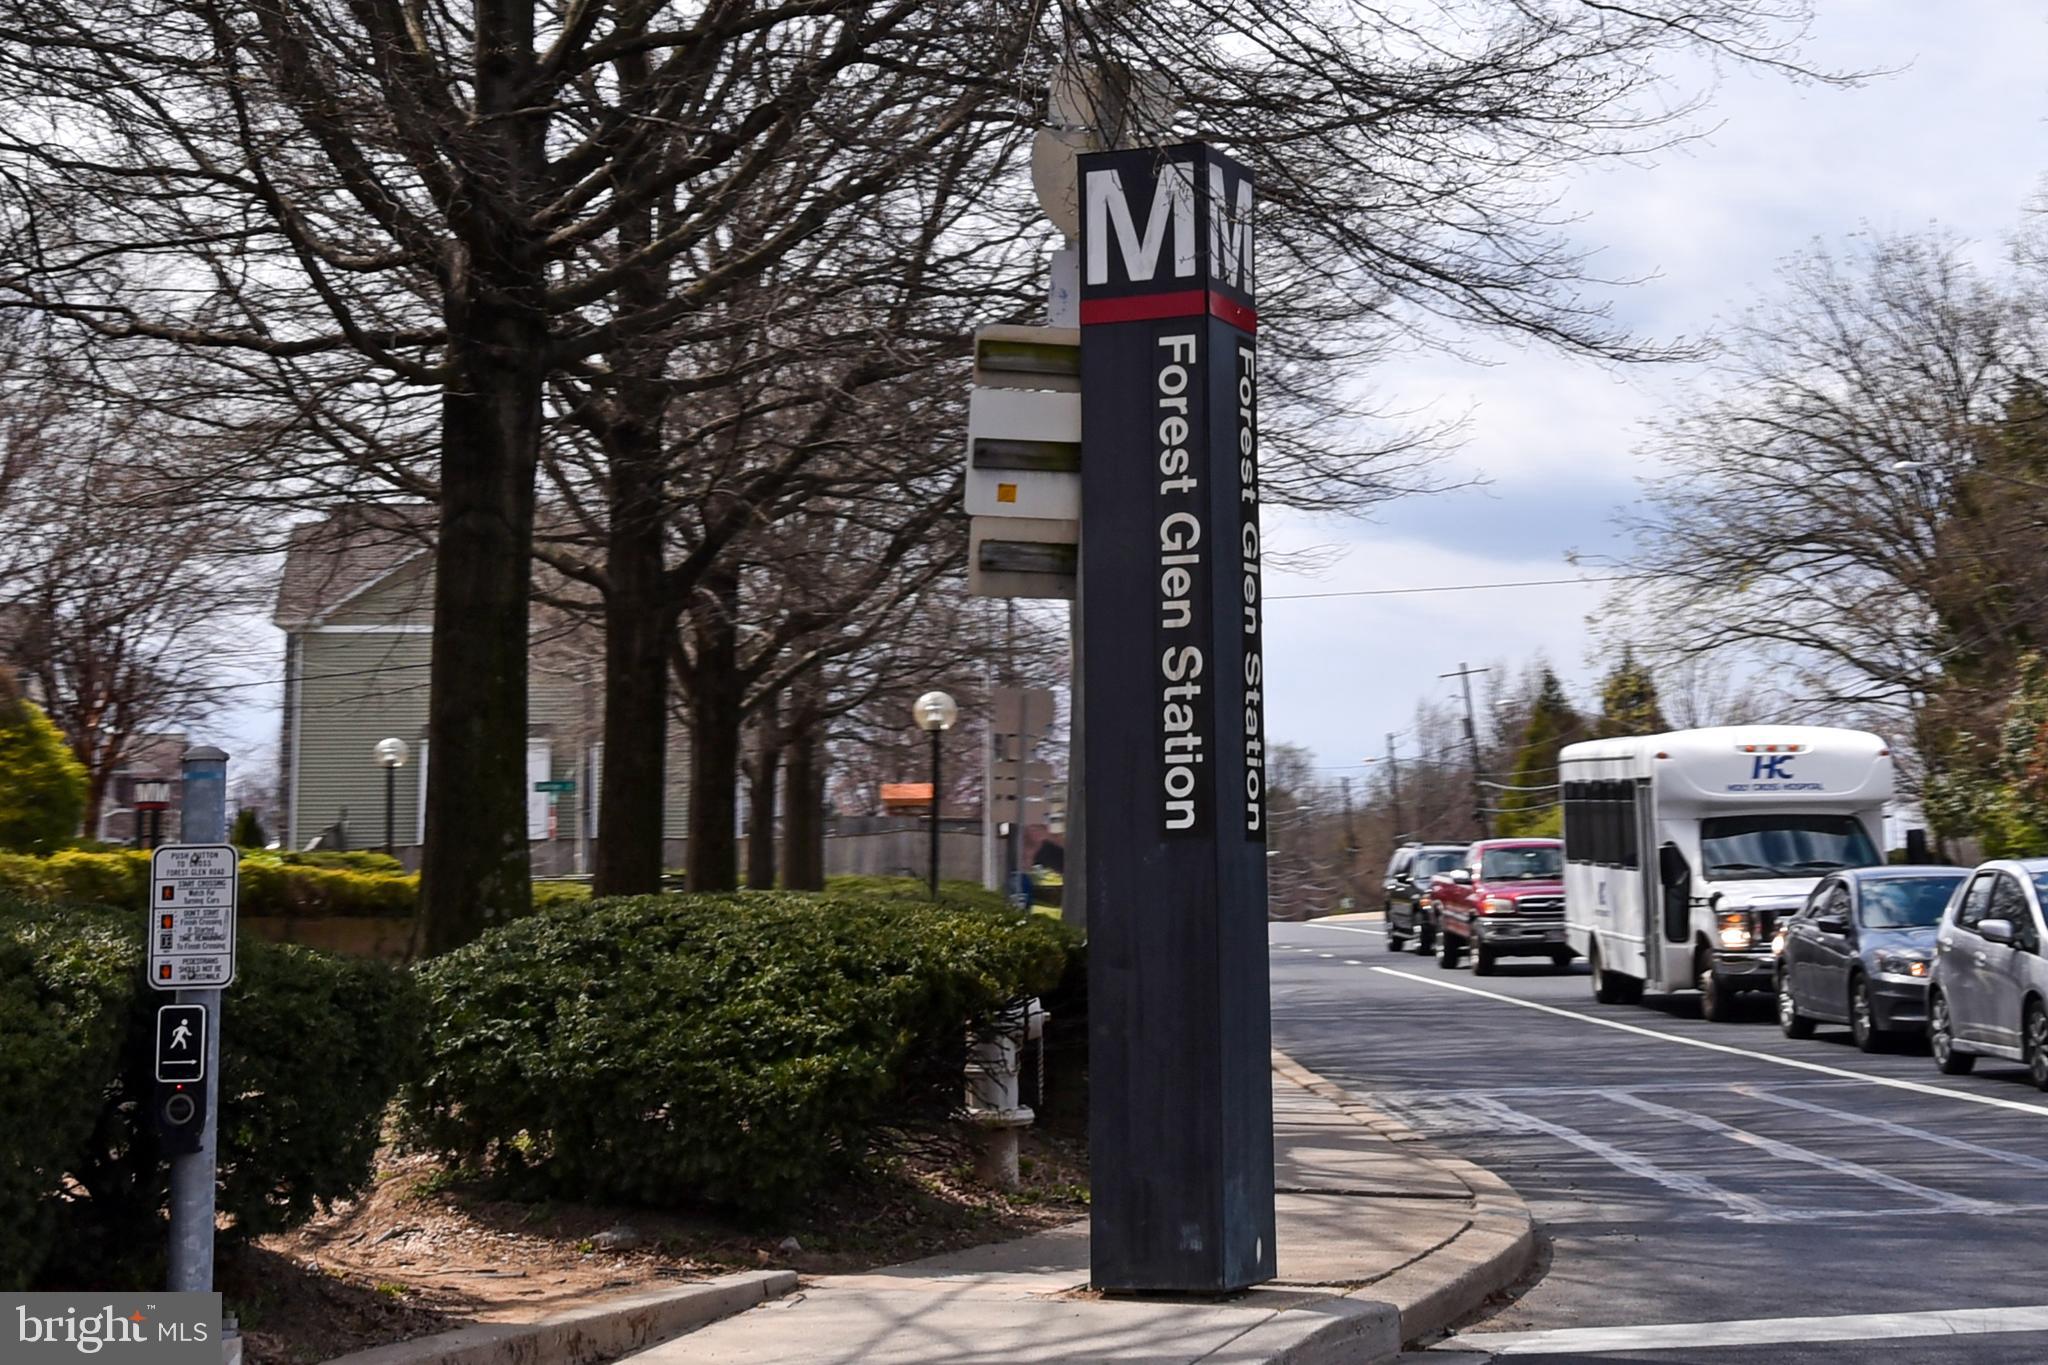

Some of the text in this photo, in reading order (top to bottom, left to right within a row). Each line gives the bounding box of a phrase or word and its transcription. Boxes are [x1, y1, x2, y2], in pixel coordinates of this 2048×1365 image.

[1086, 161, 1196, 285] M
[1209, 162, 1253, 296] M
[1158, 334, 1203, 830] Forest Glen Station
[1239, 346, 1263, 831] Forest Glen Station
[166, 867, 225, 877] FOREST GLEN ROAD
[171, 850, 219, 860] PUSH UTTON
[177, 860, 186, 868] TO
